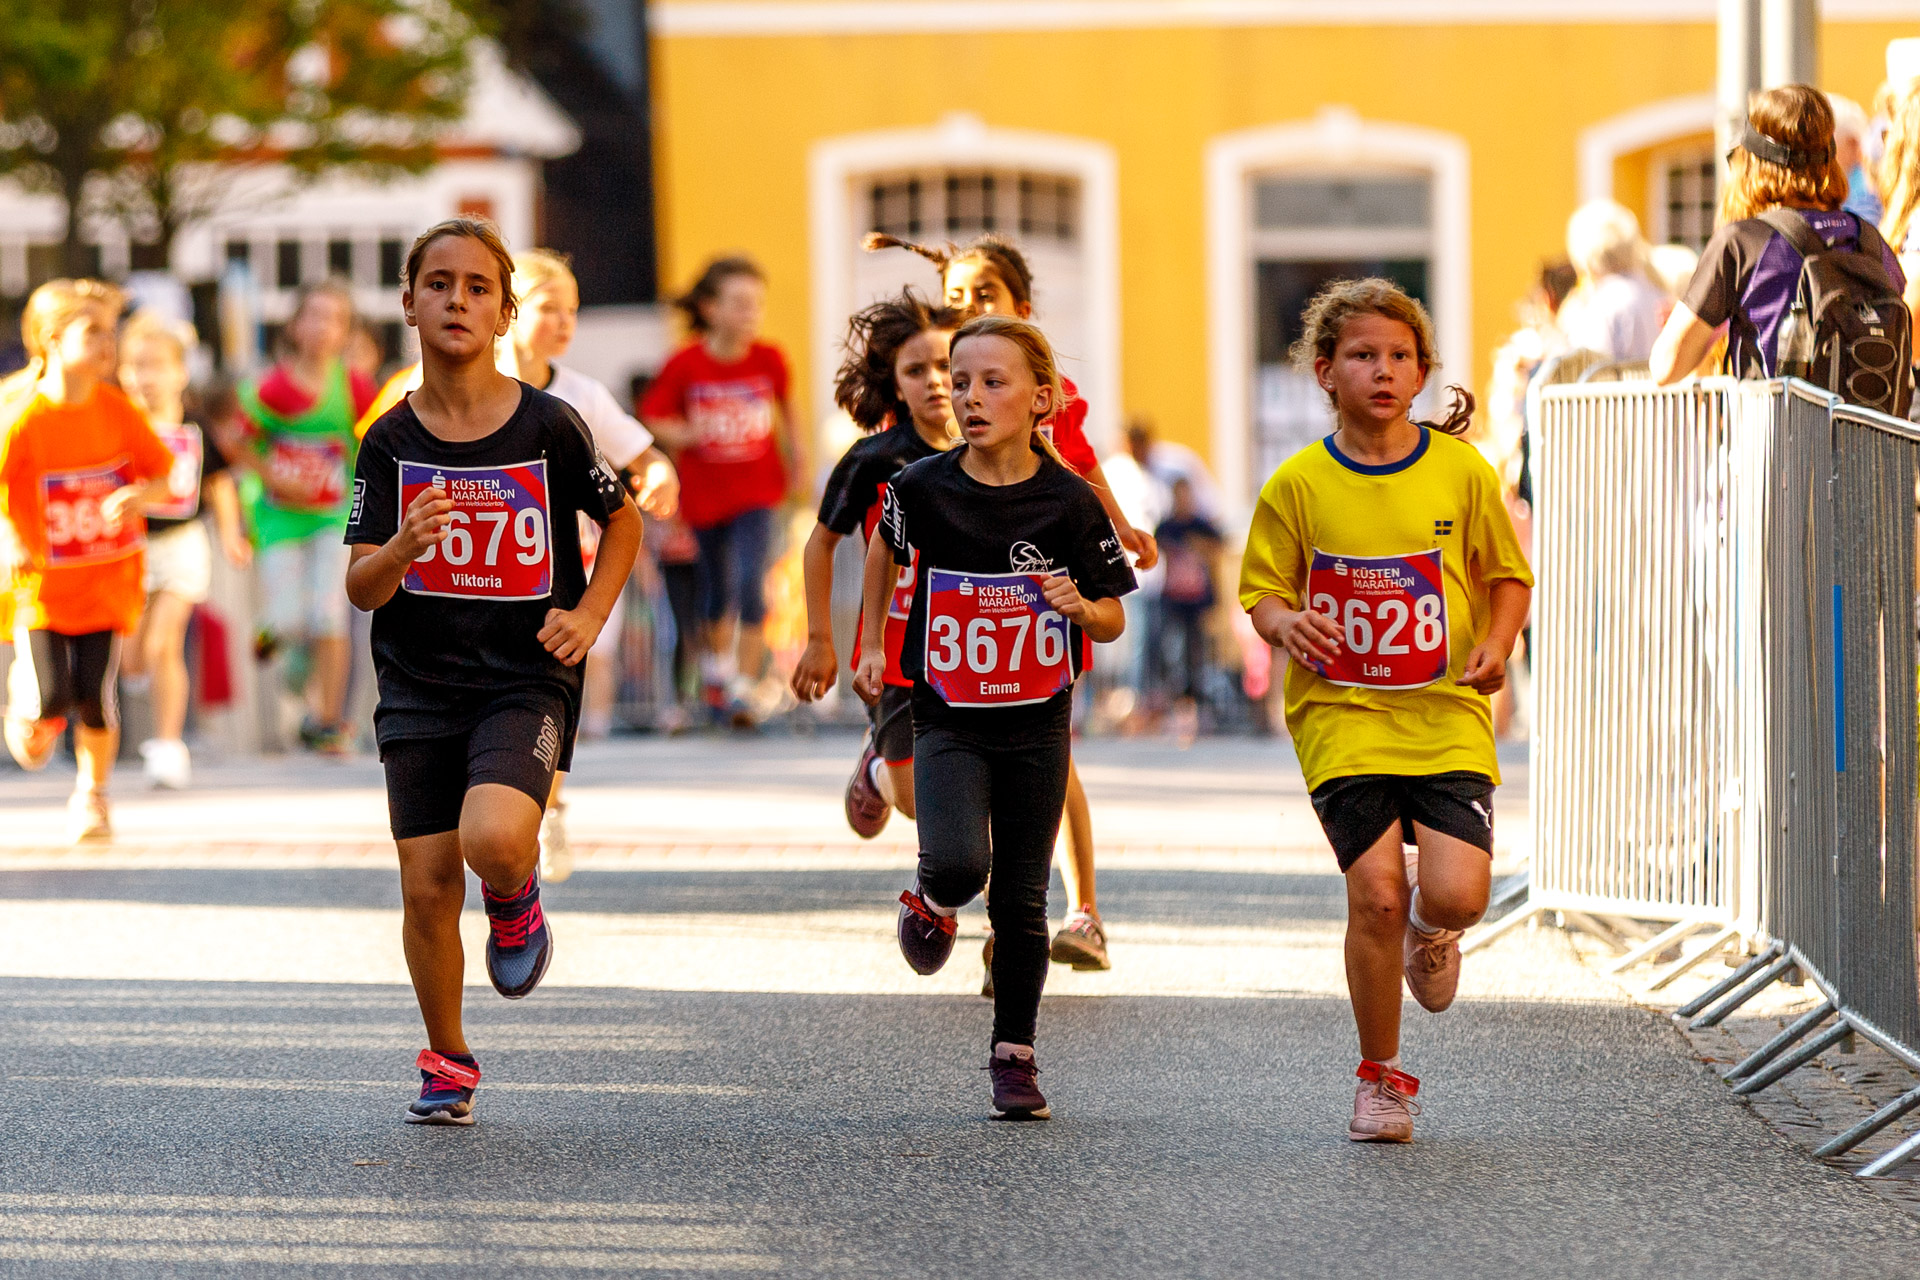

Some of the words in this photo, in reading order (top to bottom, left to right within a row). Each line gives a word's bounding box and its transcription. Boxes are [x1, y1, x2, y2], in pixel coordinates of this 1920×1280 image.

[452, 478, 500, 490] KÜSTEN
[452, 489, 516, 500] MARATHON
[465, 500, 505, 508] Weltkindertag
[414, 507, 545, 566] 679
[1352, 567, 1400, 579] KÜSTEN
[452, 573, 502, 588] Viktoria
[1353, 577, 1415, 589] MARATHON
[978, 585, 1024, 597] KÜSTEN
[979, 594, 1037, 607] MARATHON
[992, 604, 1028, 613] Weltkindertag
[930, 611, 1064, 673] 3676
[1363, 663, 1391, 677] Lale
[979, 681, 1021, 695] Emma
